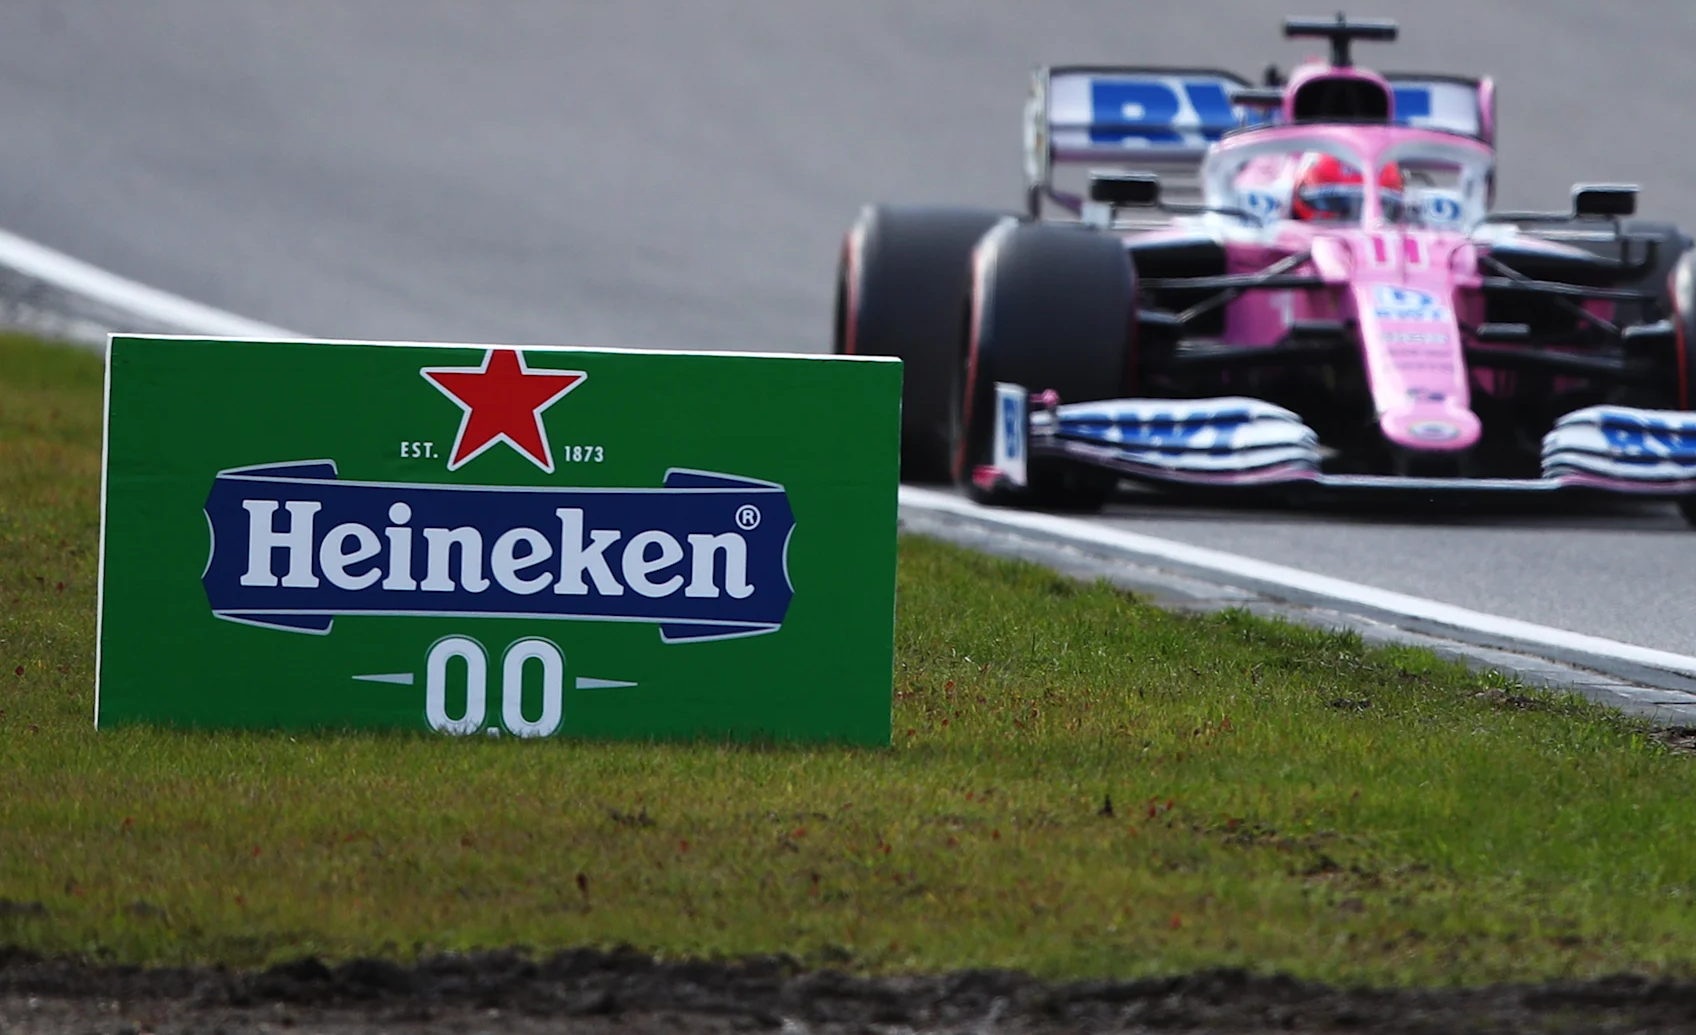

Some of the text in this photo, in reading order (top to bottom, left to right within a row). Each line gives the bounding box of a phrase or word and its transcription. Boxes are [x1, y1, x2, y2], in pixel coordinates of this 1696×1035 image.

[400, 442, 604, 462] EST. 1873
[240, 499, 755, 599] Heineken
